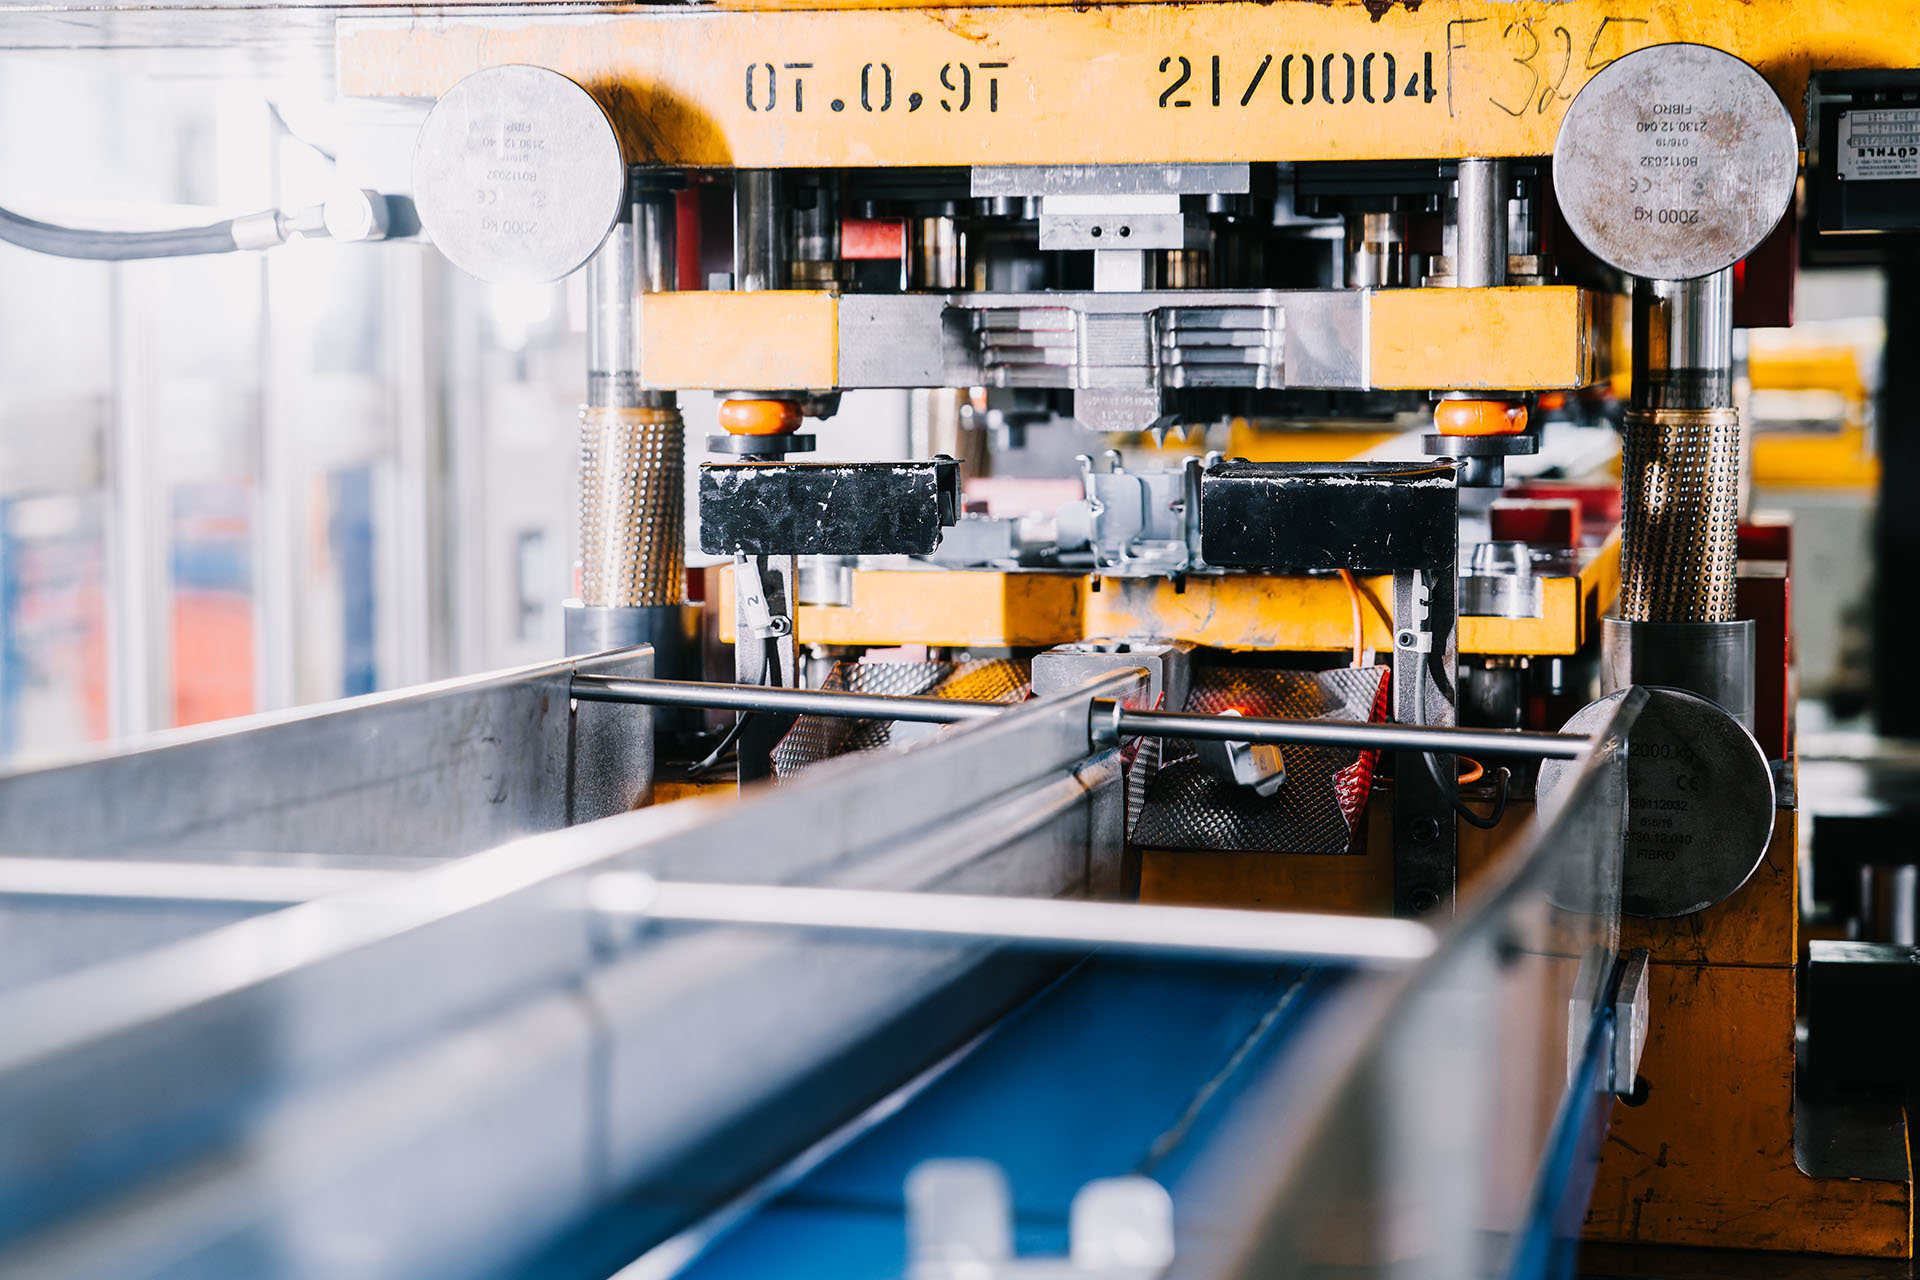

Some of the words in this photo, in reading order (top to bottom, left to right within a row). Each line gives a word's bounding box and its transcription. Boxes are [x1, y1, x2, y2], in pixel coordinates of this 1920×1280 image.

[1159, 52, 1437, 107] 21/0004
[1653, 103, 1692, 115] FIBRO
[1857, 147, 1918, 159] GÜTHLE
[1634, 206, 1653, 223] kg
[1658, 208, 1700, 224] 2000
[1631, 743, 1671, 759] 2000
[1637, 848, 1676, 861] FIBRO
